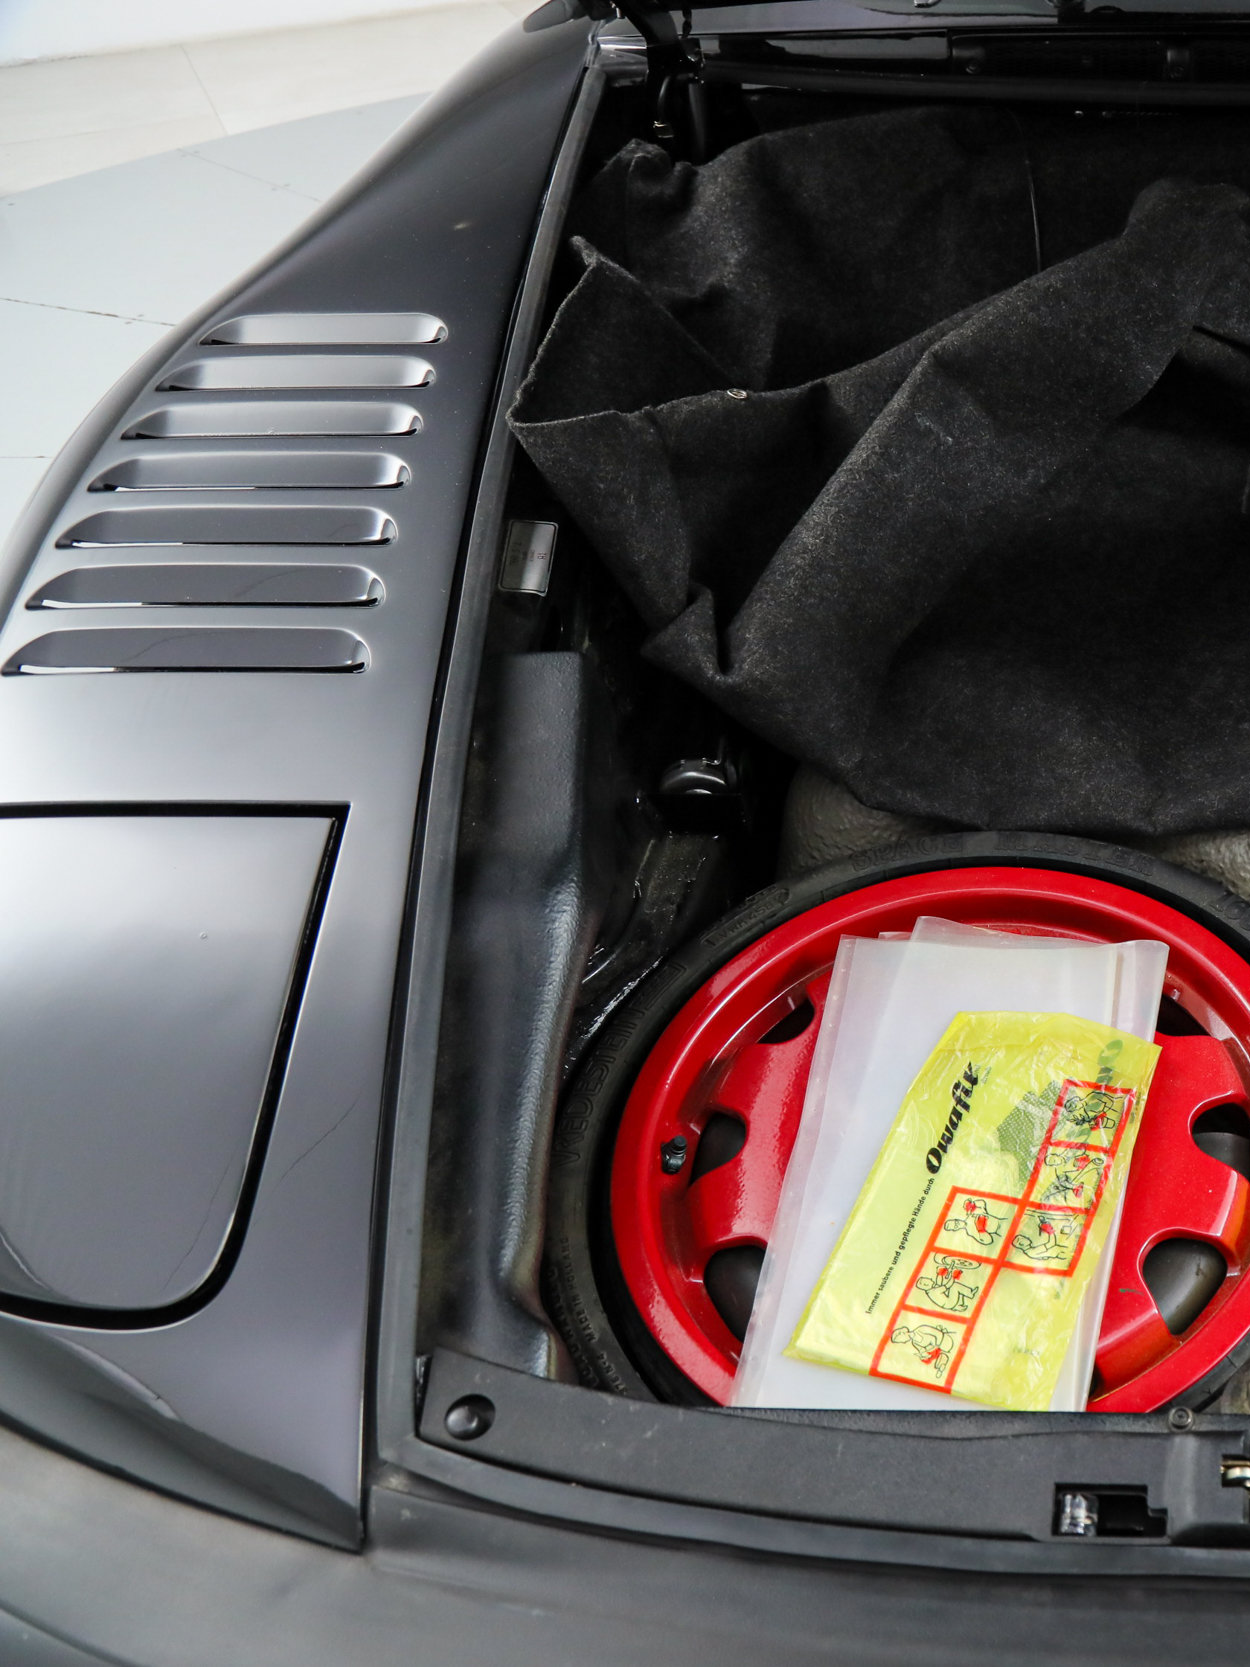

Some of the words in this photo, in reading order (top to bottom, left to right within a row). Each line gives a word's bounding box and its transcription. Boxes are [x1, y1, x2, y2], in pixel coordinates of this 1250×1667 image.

[925, 1061, 979, 1175] Owafix
[922, 1177, 935, 1196] durch
[911, 1195, 927, 1217] Hände
[898, 1217, 917, 1251] gepflegte
[891, 1250, 902, 1266] und
[877, 1266, 895, 1292] saubere
[865, 1291, 881, 1315] Immer
